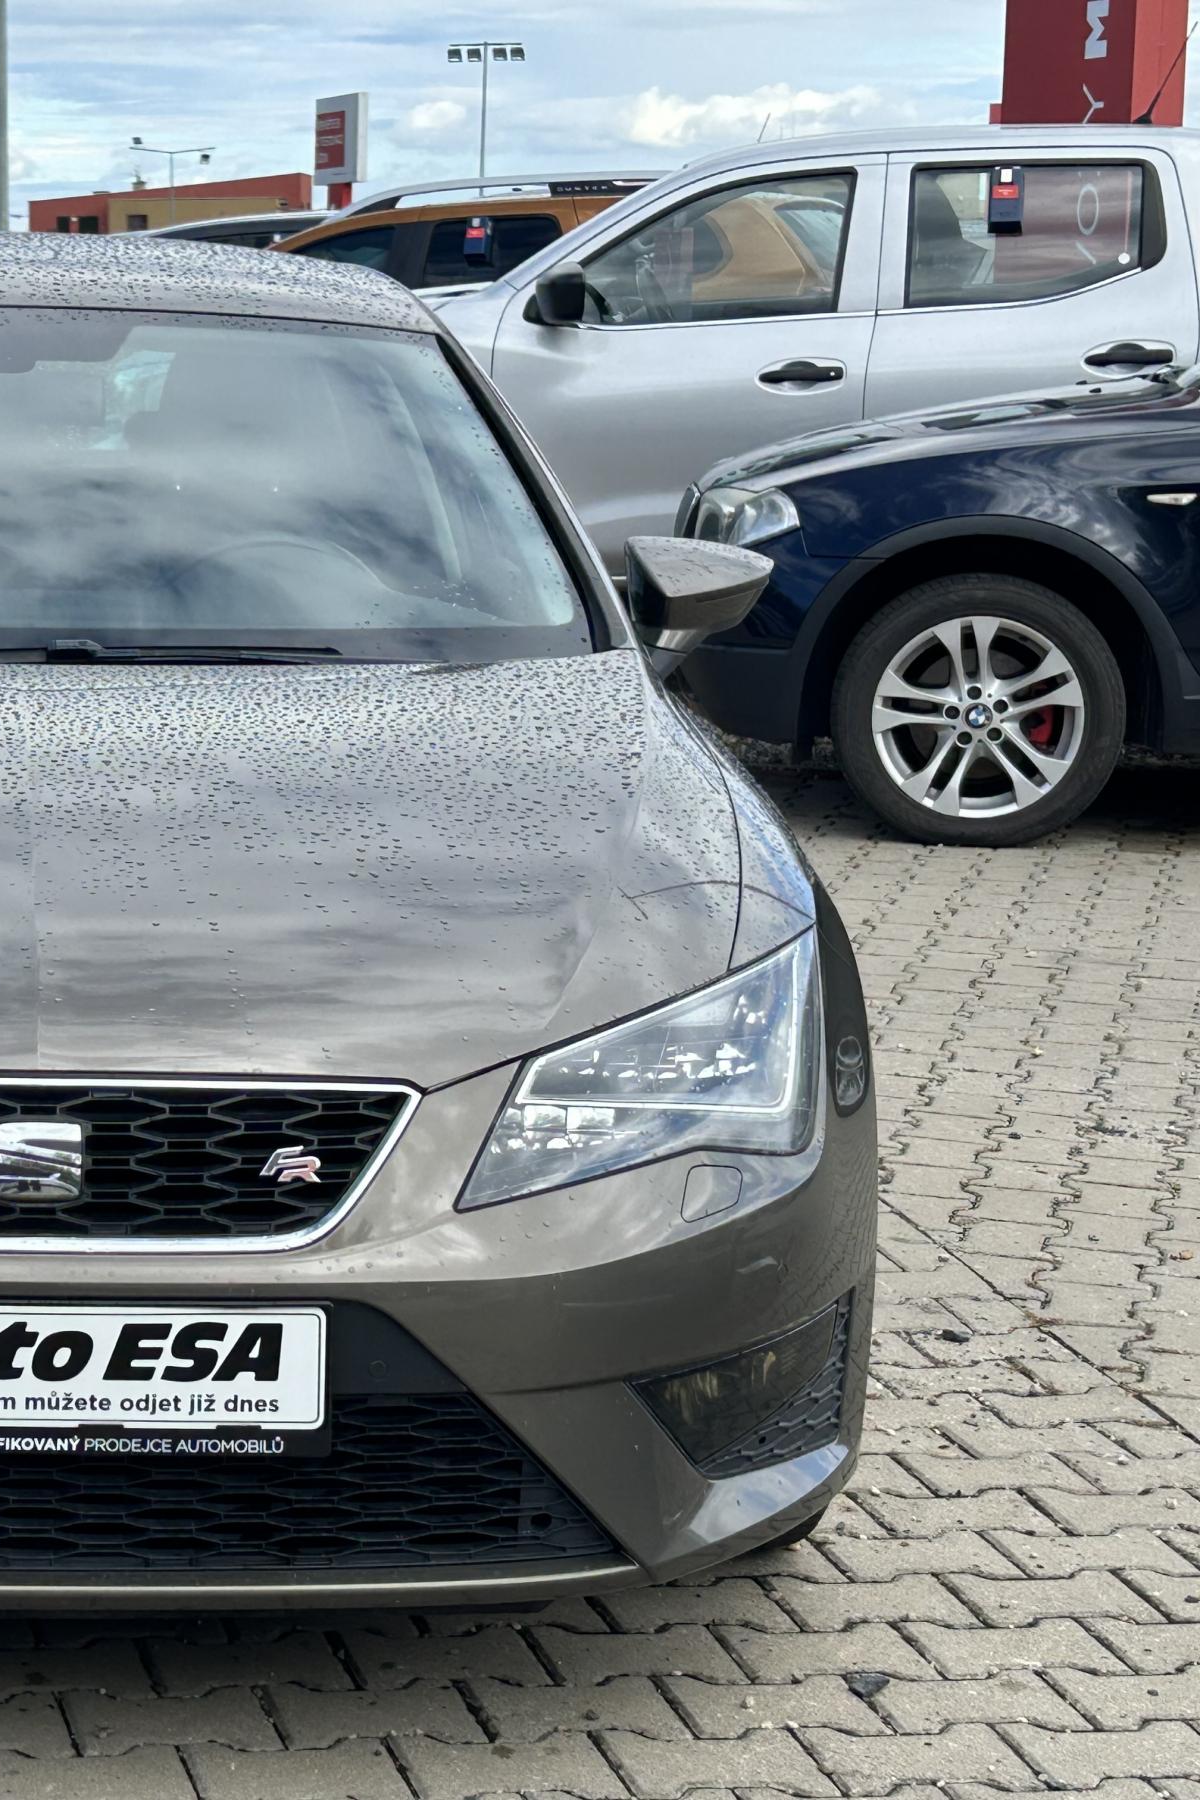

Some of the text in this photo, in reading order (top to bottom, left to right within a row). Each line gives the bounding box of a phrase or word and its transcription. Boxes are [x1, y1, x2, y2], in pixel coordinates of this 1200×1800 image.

[259, 1144, 321, 1183] FR
[102, 1321, 283, 1383] ESA
[24, 1390, 112, 1412] můžete
[119, 1393, 182, 1416] odjet
[188, 1392, 216, 1416] již
[223, 1394, 280, 1413] dnes
[83, 1437, 173, 1453] PRODEJCE
[175, 1435, 285, 1454] AUTOMOBILŮ
